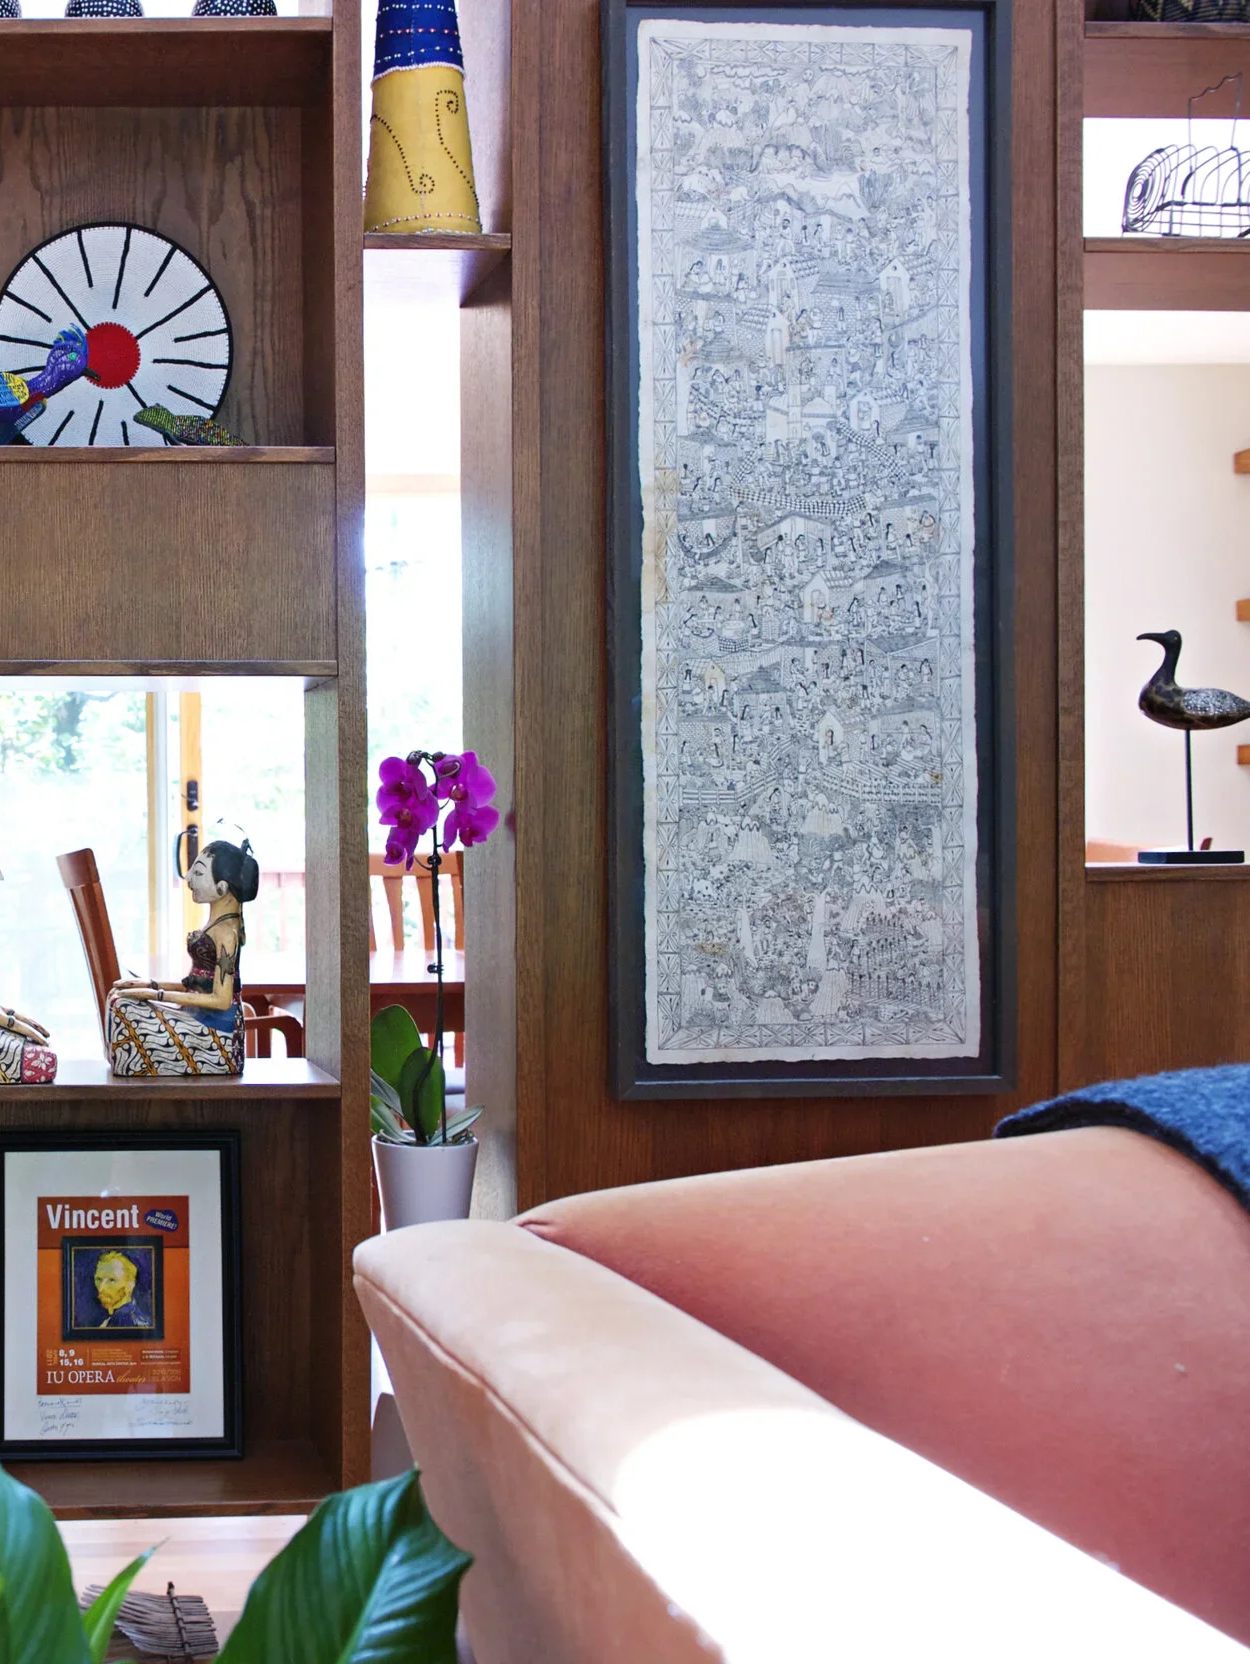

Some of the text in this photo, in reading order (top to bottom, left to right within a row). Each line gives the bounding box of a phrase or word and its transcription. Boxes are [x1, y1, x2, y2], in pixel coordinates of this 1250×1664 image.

[46, 1204, 139, 1229] Vincent
[46, 1370, 64, 1384] IU
[68, 1369, 115, 1384] OPERA
